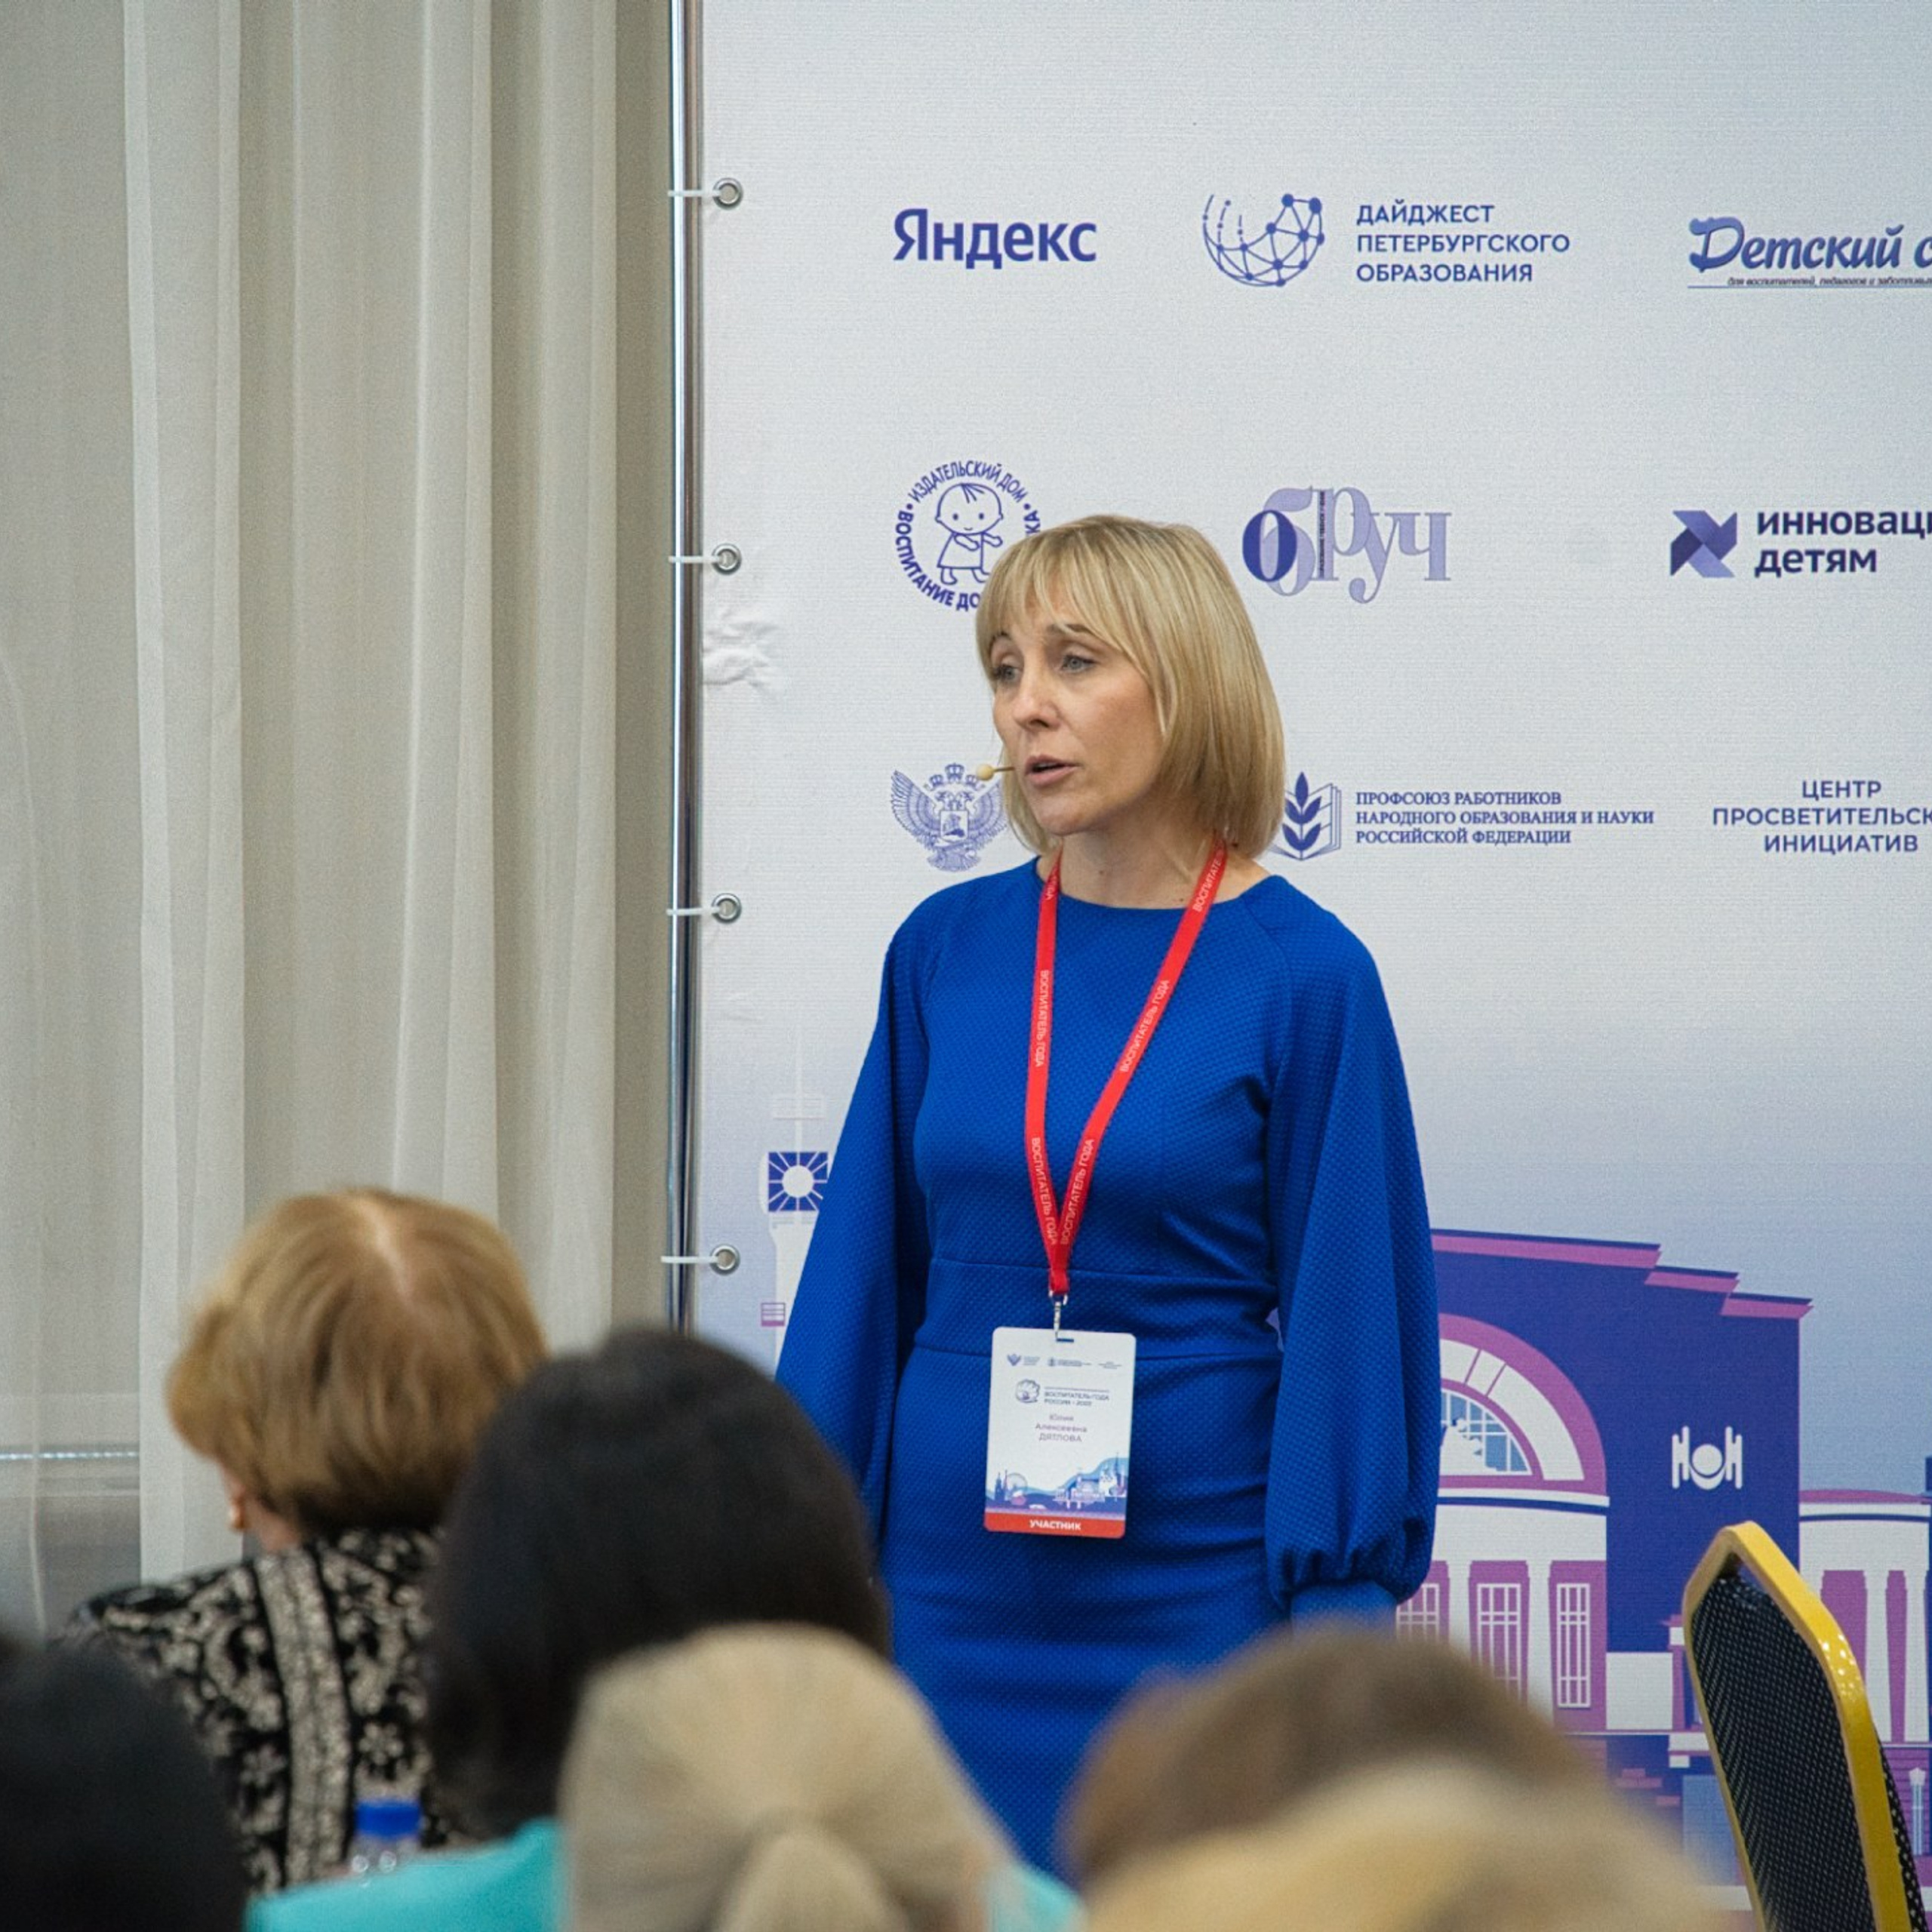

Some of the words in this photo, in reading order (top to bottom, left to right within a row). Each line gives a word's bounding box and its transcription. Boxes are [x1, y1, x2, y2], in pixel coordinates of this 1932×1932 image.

[1356, 198, 1495, 226] ДАЙДЖЕСТ
[893, 208, 1097, 269] Яндекс
[1357, 234, 1571, 252] ПЕТЕРБУРГСКОГО
[1689, 217, 1905, 273] Детский
[1356, 263, 1533, 282] ОБРАЗОВАНИЯ
[908, 460, 1002, 503] ИЗДАТЕЛЬСКИЙ
[997, 473, 1029, 503] ДОМ
[1757, 512, 1932, 540] инновац
[895, 510, 955, 607] ВОСПИТАНИЕ
[1755, 549, 1877, 578] детям
[1356, 792, 1450, 805] ПРОФСОЮЗ
[1454, 792, 1561, 805] РАБОТНИКОВ
[1802, 780, 1882, 801] ЦЕНТР
[1356, 811, 1456, 826] НАРОДНОГО
[1460, 811, 1577, 825] ОБРАЗОВАНИЯ
[1581, 811, 1593, 824] И
[1598, 811, 1654, 824] НАУКИ
[1713, 808, 1932, 826] ПРОСВЕТИТЕЛЬСК
[1356, 828, 1468, 844] РОССИЙСКОЙ
[1472, 831, 1571, 846] ФЕДЕРАЦИИ
[1764, 835, 1918, 855] ИНИЦИАТИВ
[1029, 1519, 1081, 1531] УЧАСТНИК
